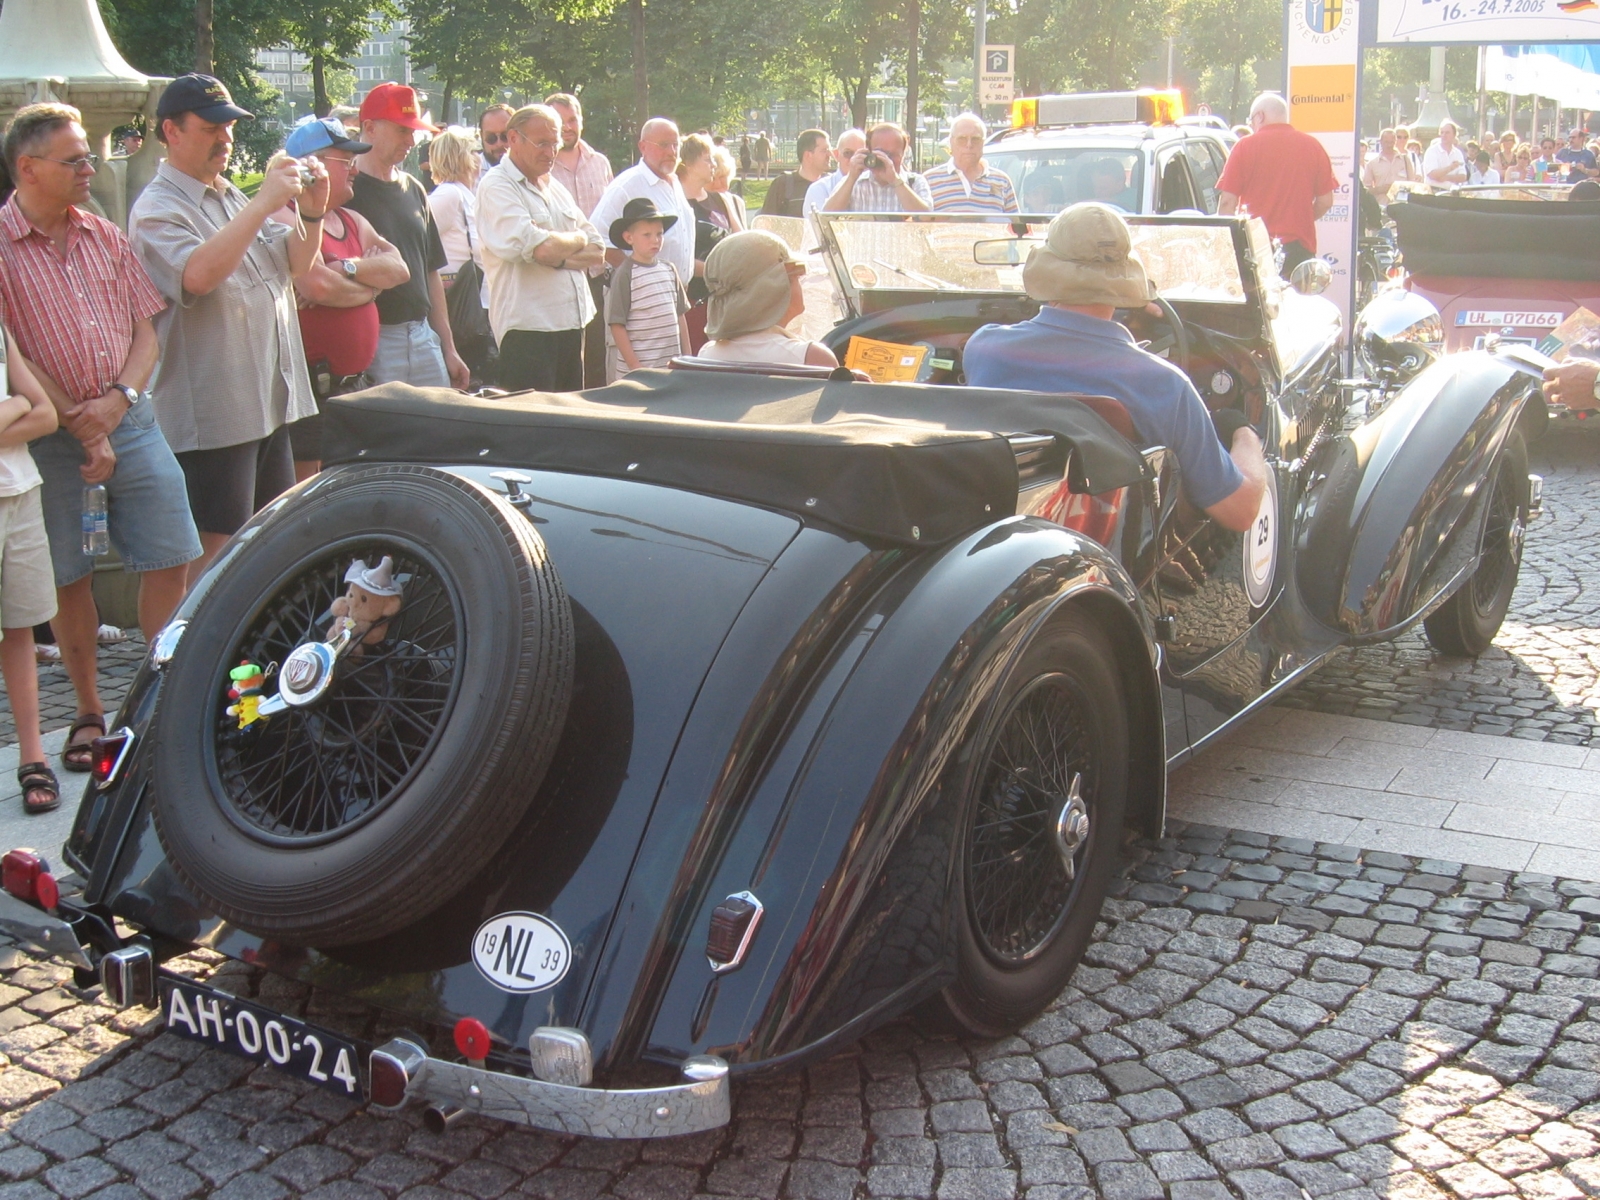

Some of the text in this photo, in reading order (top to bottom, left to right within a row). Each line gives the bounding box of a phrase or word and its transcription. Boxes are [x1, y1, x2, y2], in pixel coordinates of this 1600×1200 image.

[993, 57, 1003, 70] P
[1291, 94, 1345, 105] Continental
[1469, 312, 1558, 325] UL 07066
[1257, 514, 1269, 547] 29
[481, 924, 561, 982] 19 NL 39
[168, 988, 356, 1093] AH-00-24
